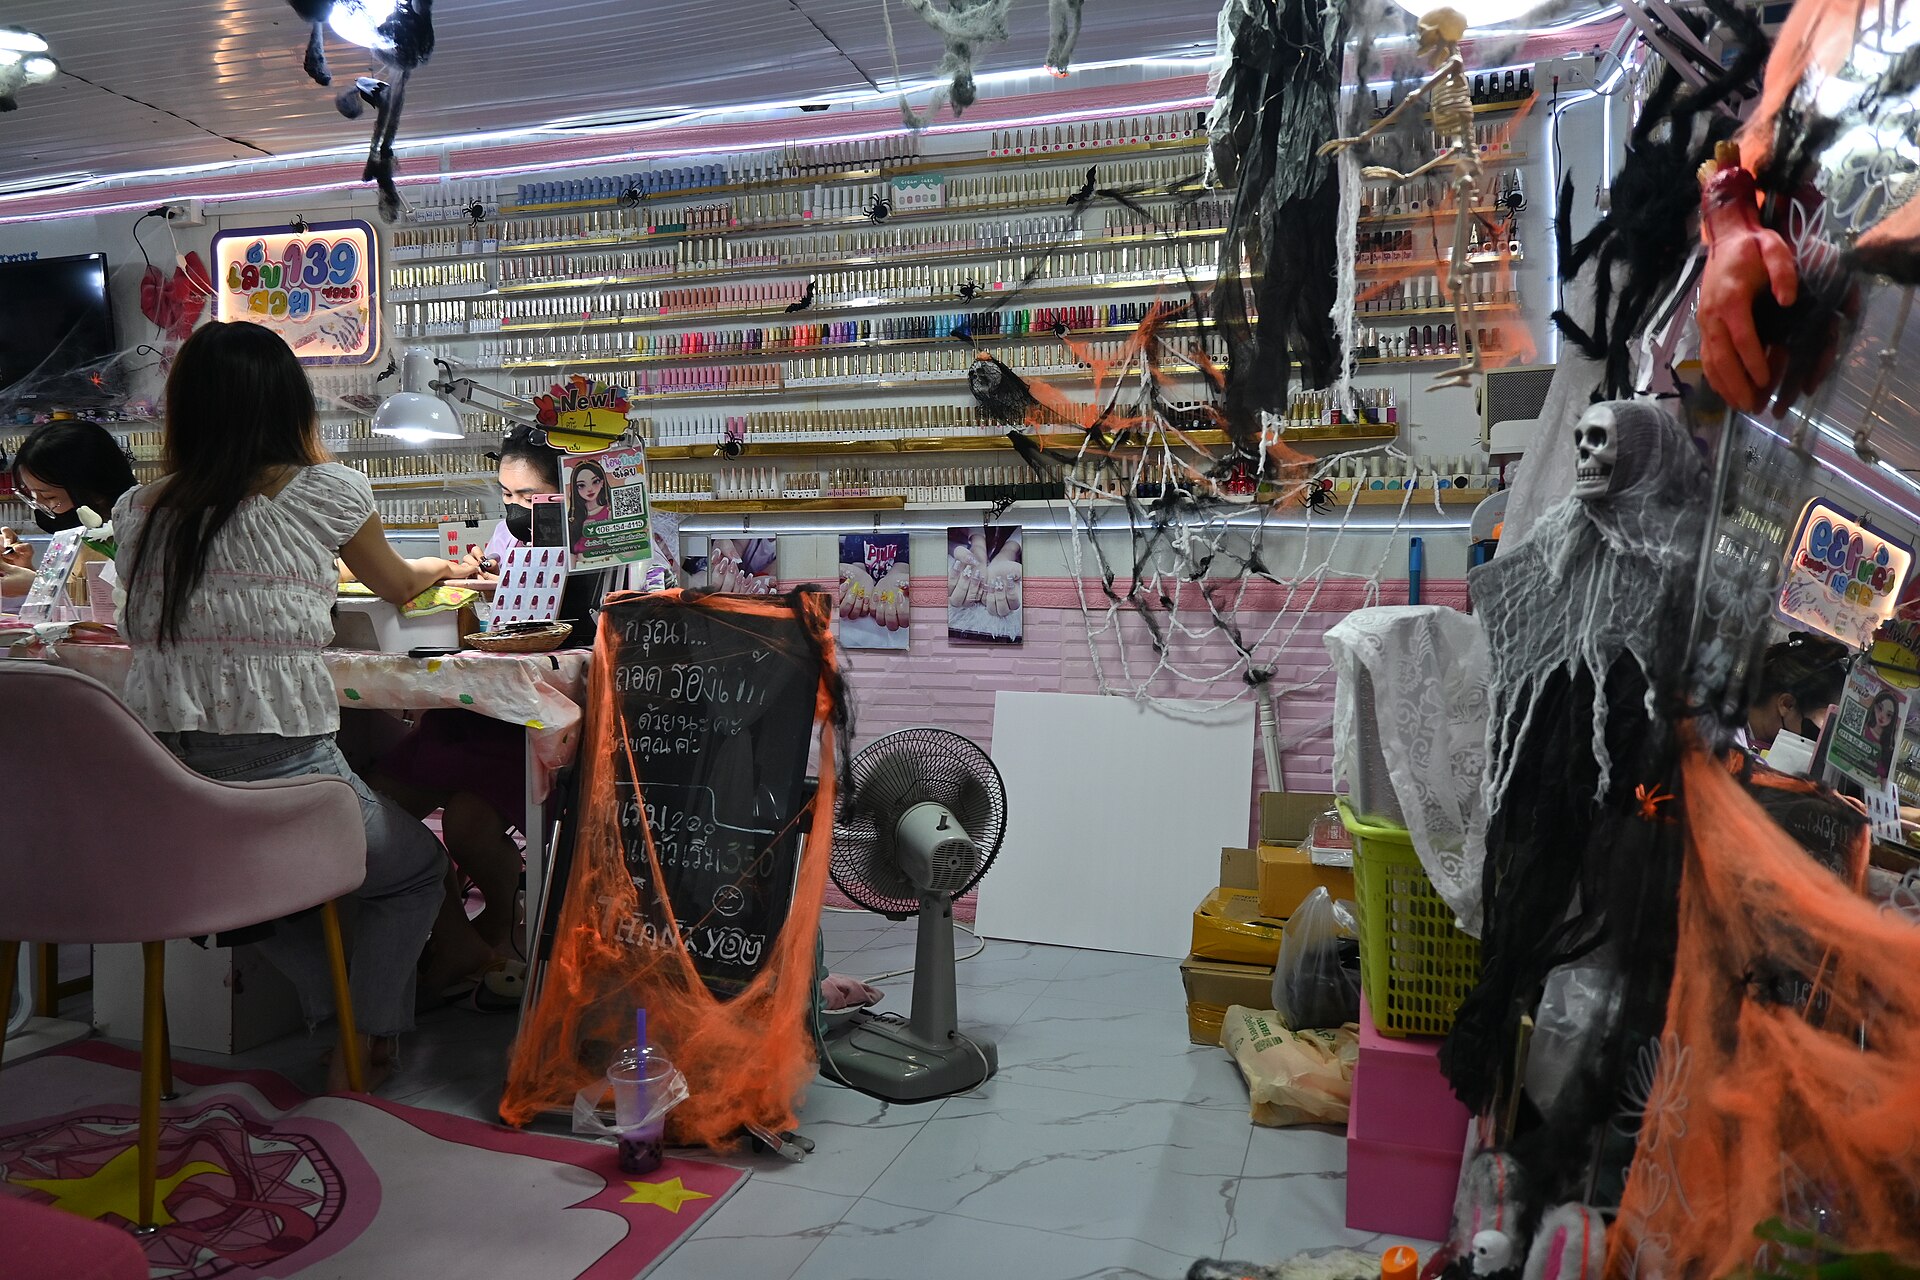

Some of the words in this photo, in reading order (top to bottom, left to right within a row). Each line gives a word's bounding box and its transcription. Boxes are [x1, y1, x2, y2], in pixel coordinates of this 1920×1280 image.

[227, 241, 281, 291] เล็บ
[283, 241, 357, 286] 139
[248, 289, 310, 319] สวย
[560, 388, 618, 412] New!
[583, 411, 597, 432] 4
[703, 927, 765, 966] YOU
